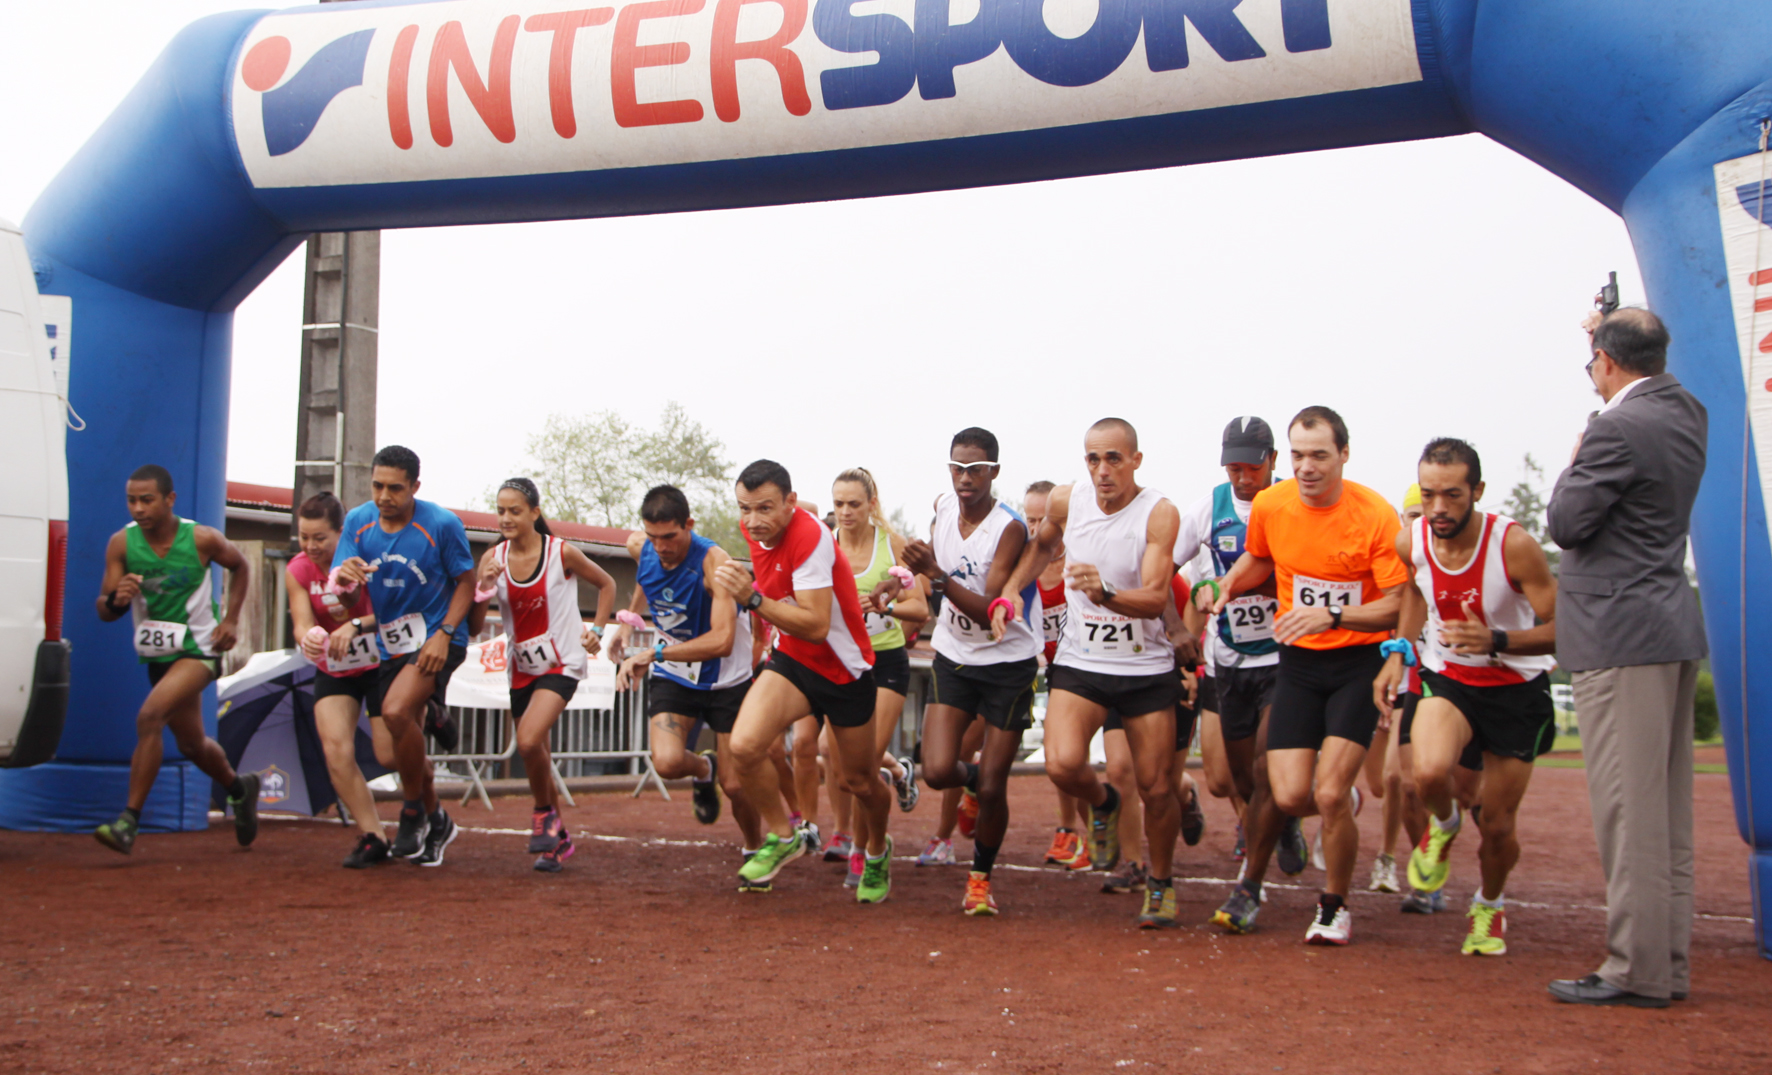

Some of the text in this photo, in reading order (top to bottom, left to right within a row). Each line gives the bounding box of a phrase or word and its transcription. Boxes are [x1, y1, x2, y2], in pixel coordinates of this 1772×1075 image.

[1300, 587, 1350, 607] 611
[1233, 601, 1277, 627] 291
[139, 629, 175, 648] 281
[386, 623, 413, 644] 51
[1085, 622, 1133, 642] 721
